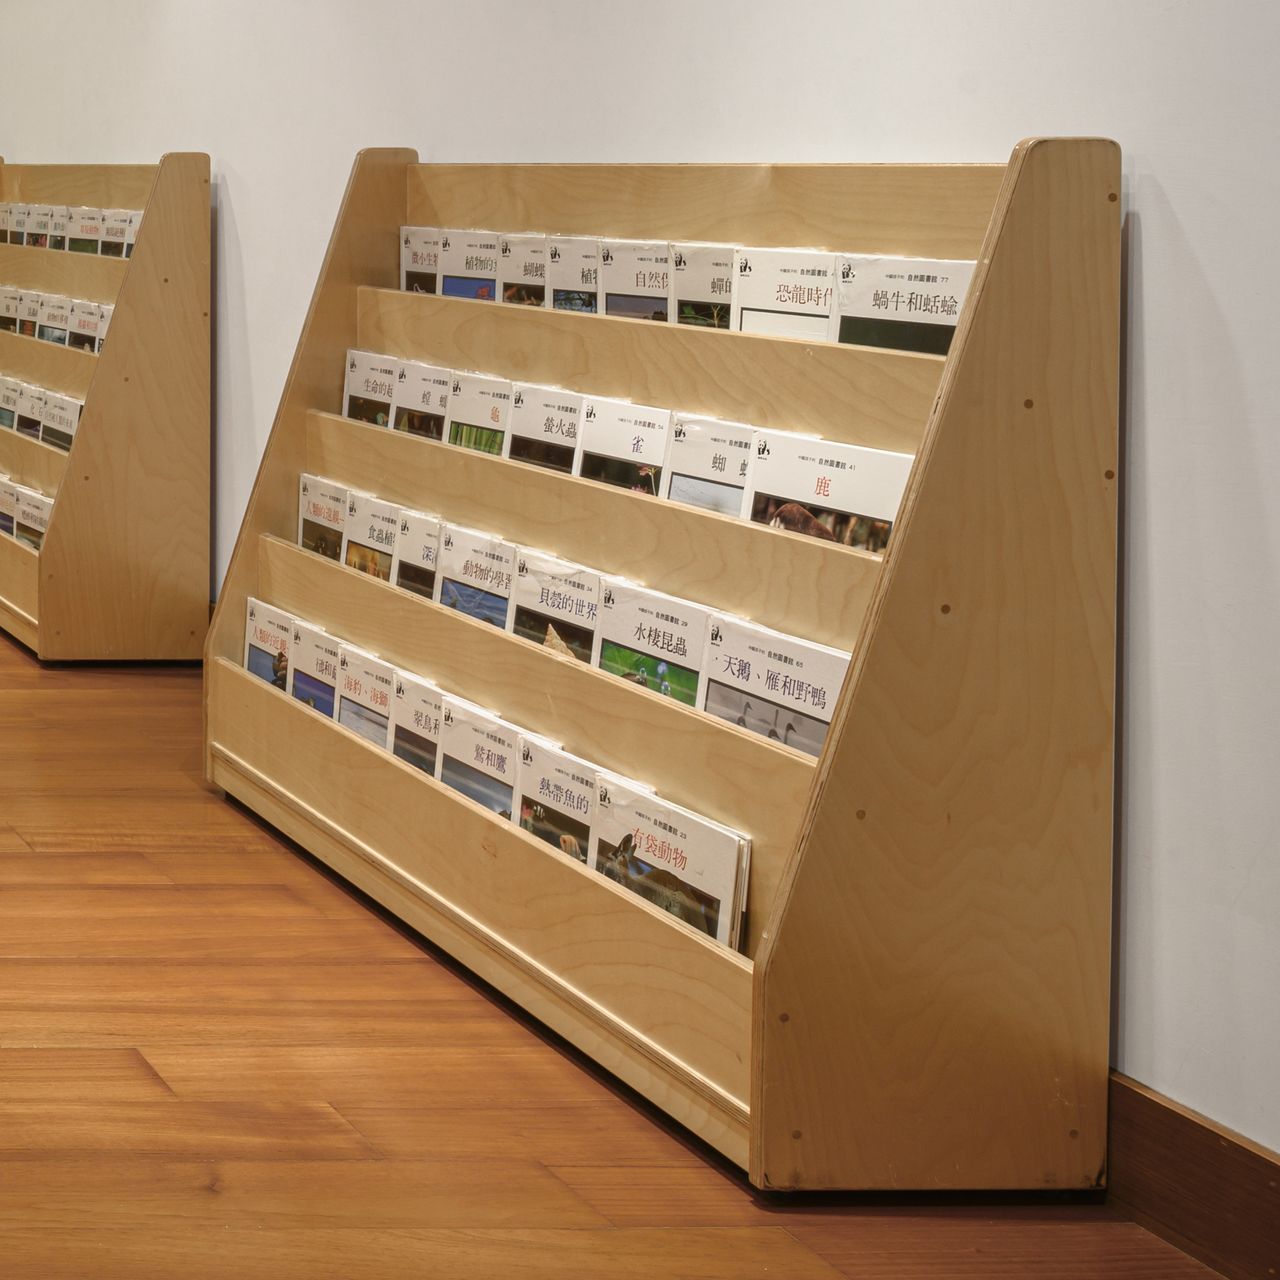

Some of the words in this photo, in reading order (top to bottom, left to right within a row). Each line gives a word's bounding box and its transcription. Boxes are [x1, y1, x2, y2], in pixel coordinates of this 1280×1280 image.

[872, 289, 958, 316] 蝸牛和蛞蝓
[543, 416, 577, 439] 螢火蟲
[631, 435, 645, 454] 雀
[815, 476, 832, 497] 鹿
[539, 587, 598, 621] 貝殼的世界
[633, 622, 688, 658] 水棲昆蟲
[632, 827, 688, 871] 有袋動物
